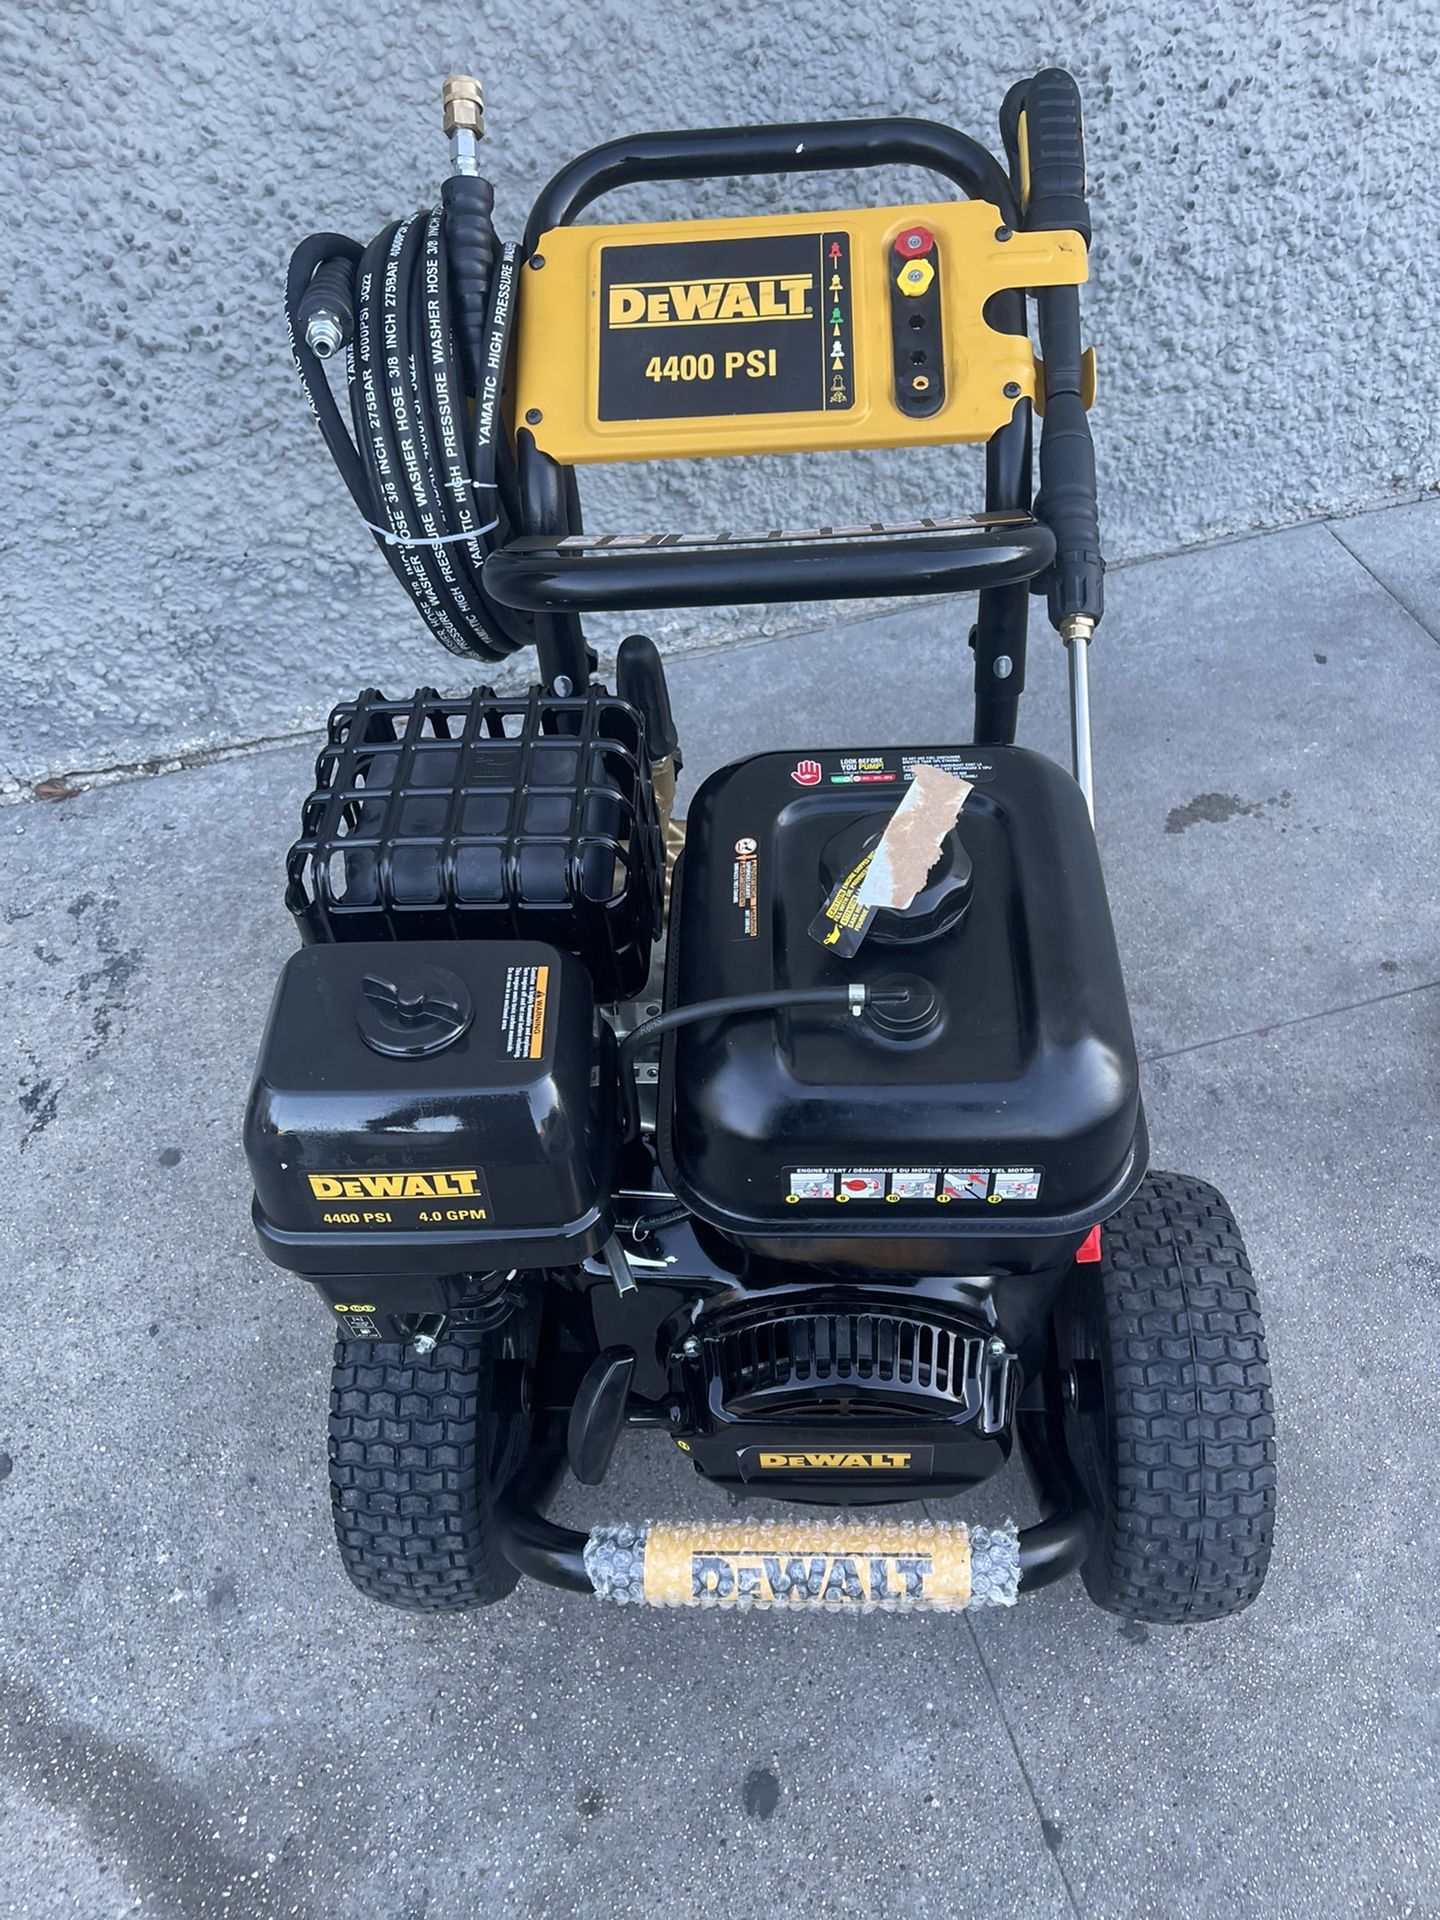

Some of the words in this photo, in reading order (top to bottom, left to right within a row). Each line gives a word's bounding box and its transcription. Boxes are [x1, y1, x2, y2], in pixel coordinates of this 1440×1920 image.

[427, 240, 438, 254] 3/8
[361, 273, 372, 302] 3Q22
[385, 260, 398, 307] 275BAR
[427, 260, 438, 293] HOSE
[494, 264, 512, 325] PRESSURE
[360, 308, 370, 361] 4000PSI
[385, 314, 397, 349] INCH
[428, 300, 443, 365] WASHER
[488, 332, 503, 368] HIGH
[388, 356, 400, 378] 3/8
[645, 353, 714, 383] 4400
[725, 349, 776, 379] PSI
[363, 369, 381, 429] 275BAR
[391, 387, 409, 431] HOSE
[435, 372, 457, 458] PRESSURE
[479, 376, 497, 446] YAMATIC
[373, 437, 390, 474] INCH
[401, 438, 427, 507] WASHER
[385, 482, 399, 503] 3/8
[449, 466, 466, 502] HIGH
[421, 513, 456, 583] PRESSURE
[459, 510, 483, 568] YAMTIC
[410, 555, 440, 606] WASHER
[450, 587, 471, 612] HIGH
[534, 1000, 543, 1035] WARNING
[323, 1213, 360, 1223] 4400
[363, 1213, 392, 1223] PSI
[419, 1211, 442, 1222] 4.0
[446, 1210, 486, 1221] GPM
